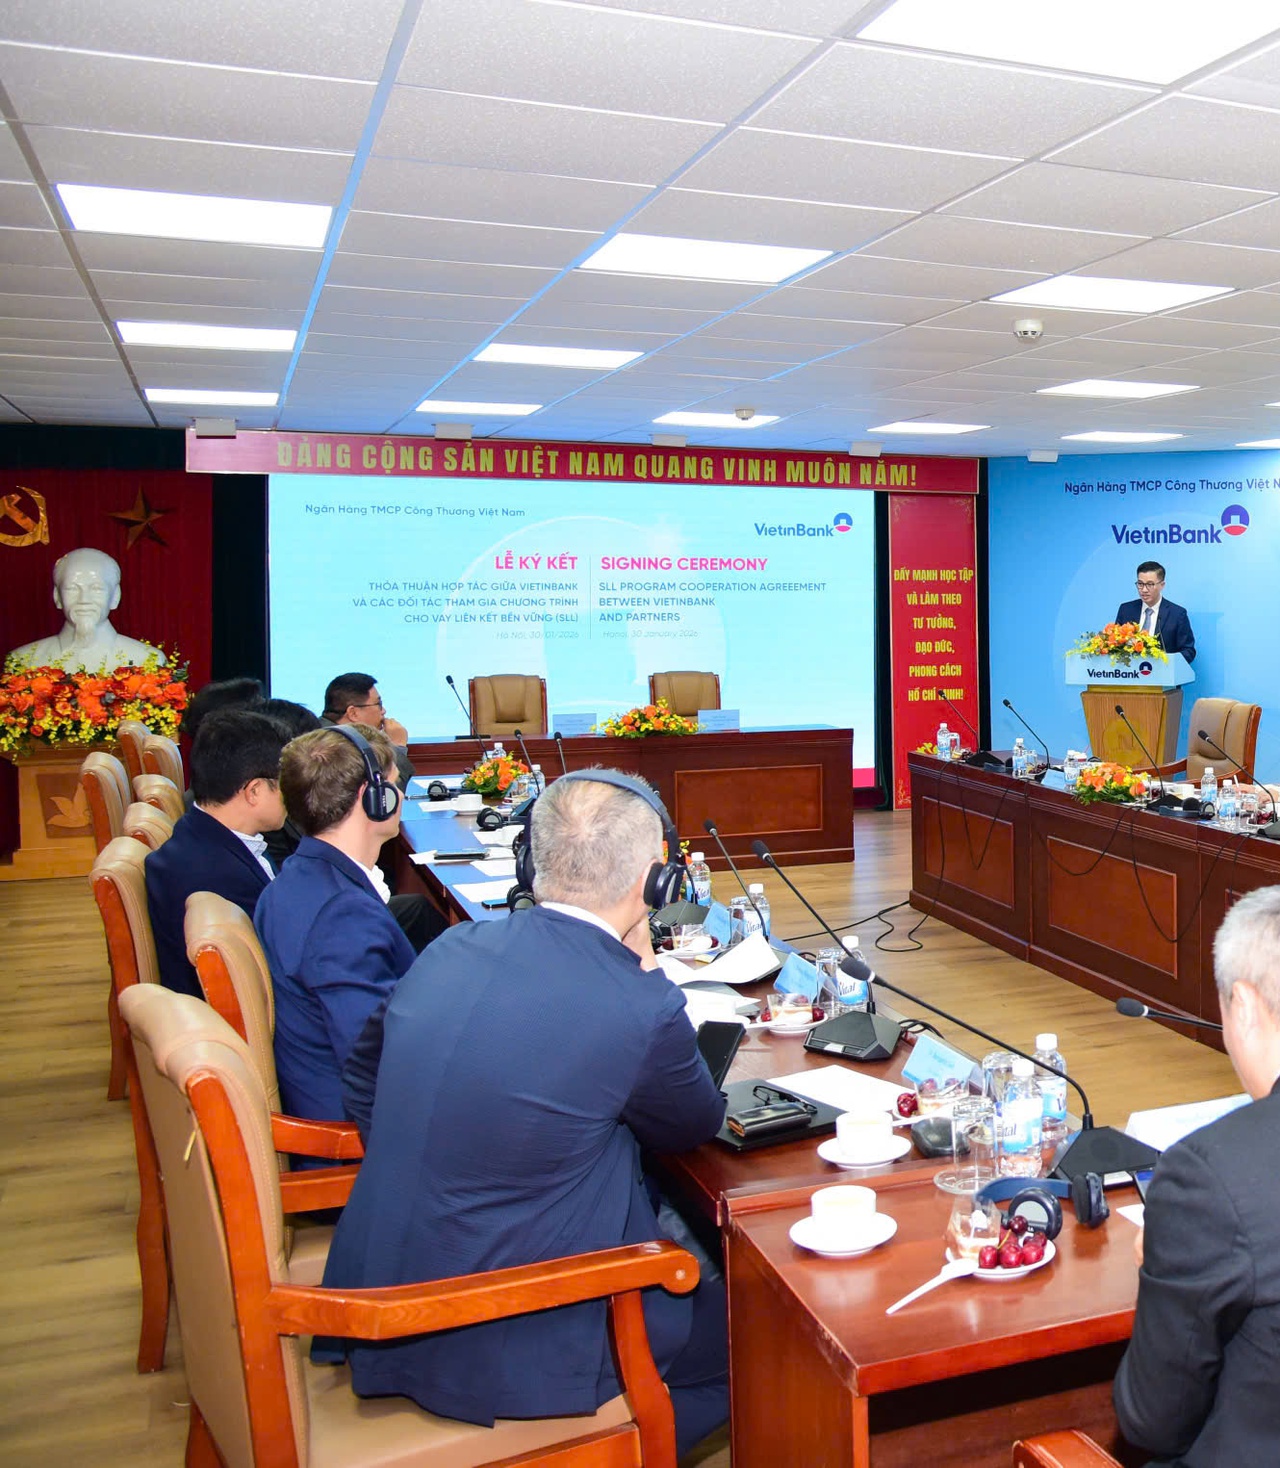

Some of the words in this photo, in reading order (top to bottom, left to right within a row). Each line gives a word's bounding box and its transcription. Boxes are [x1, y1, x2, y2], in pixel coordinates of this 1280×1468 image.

[277, 438, 351, 468] ĐẢNG
[362, 440, 433, 474] CỘNG
[444, 442, 494, 472] SẢN
[505, 445, 559, 478] VIỆT
[569, 452, 624, 477] NAM
[634, 454, 714, 480] QUANG
[723, 457, 777, 482] VINH
[786, 457, 850, 484] MUÔN
[859, 460, 917, 486] NĂM!
[1064, 480, 1094, 496] Ngân
[1097, 480, 1127, 495] Hàng
[1130, 480, 1162, 492] TMCP
[1165, 479, 1196, 493] Công
[1199, 479, 1243, 493] Thương
[1246, 478, 1271, 491] Việt
[305, 504, 335, 515] Ngân
[338, 505, 367, 515] Hàng
[370, 505, 401, 514] TMCP
[404, 506, 433, 516] Công
[436, 507, 475, 517] Thương
[478, 507, 498, 518] Việt
[501, 508, 525, 517] Nam
[754, 523, 834, 537] VietinBank
[1111, 523, 1223, 545] VietinBank
[495, 550, 514, 570] LỄ
[519, 552, 542, 570] KÝ
[547, 551, 578, 570] KẾT
[601, 556, 673, 571] SIGNING
[677, 557, 768, 571] CEREMONY
[912, 569, 938, 584] MẠNH
[940, 569, 957, 584] HỌC
[959, 567, 974, 584] TẬP
[402, 580, 438, 593] THUẬN
[441, 582, 464, 593] HỢP
[467, 581, 488, 591] TÁC
[519, 582, 578, 591] VIETINBANK
[599, 582, 617, 591] SLL
[620, 582, 676, 591] PROGRAM
[679, 582, 757, 591] COOPERATION
[352, 597, 367, 607] VÀ
[370, 597, 395, 607] CÁC
[397, 596, 418, 607] ĐỐI
[421, 597, 442, 607] TÁC
[445, 598, 475, 607] THAM
[477, 598, 497, 607] GIA
[499, 598, 547, 607] CHƯƠNG
[549, 597, 579, 607] TRÌNH
[599, 597, 650, 606] BETWEEN
[653, 597, 716, 606] VIETINBANK
[906, 591, 918, 605] VÀ
[920, 591, 939, 605] LÀM
[941, 593, 962, 605] THEO
[404, 614, 429, 623] CHO
[432, 614, 452, 623] VAY
[454, 612, 476, 623] LIÊN
[479, 612, 498, 622] KẾT
[555, 613, 579, 623] (SLL)
[599, 612, 623, 622] AND
[626, 612, 681, 622] PARTNERS
[912, 617, 924, 629] TƯ
[926, 613, 957, 630] TƯỞNG,
[631, 630, 643, 638] 30
[643, 630, 678, 639] January
[915, 641, 933, 656] ĐẠO
[935, 639, 955, 654] ĐỨC,
[909, 665, 938, 678] PHONG
[939, 662, 962, 677] CÁCH
[1087, 668, 1140, 679] VietinBank
[922, 687, 937, 701] CHÍ
[838, 981, 856, 996] Vital
